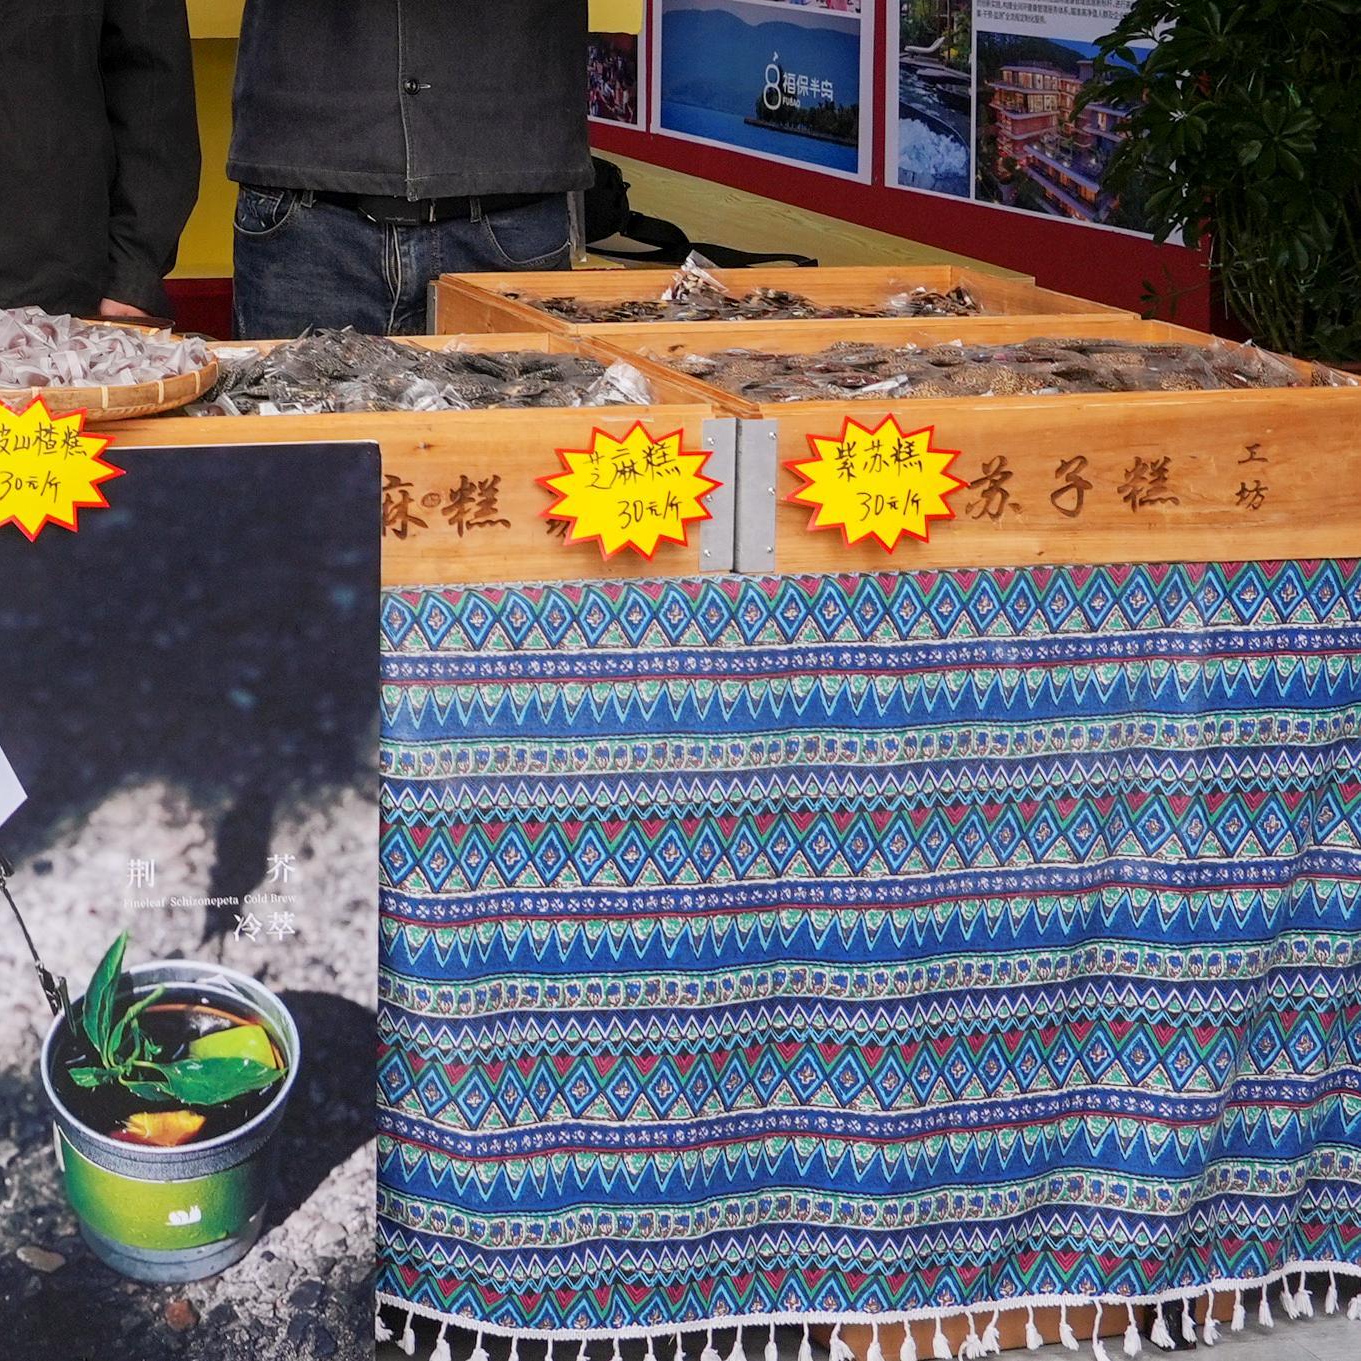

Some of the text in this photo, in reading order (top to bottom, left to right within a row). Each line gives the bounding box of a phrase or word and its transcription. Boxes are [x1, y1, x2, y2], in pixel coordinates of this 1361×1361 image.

[583, 442, 681, 489] 芝麻糕
[834, 439, 925, 482] 紫苏糕
[1235, 444, 1270, 511] 工坊
[169, 894, 239, 908] Schizonepeta
[243, 893, 268, 905] Cold
[232, 911, 296, 942] 冷萃
